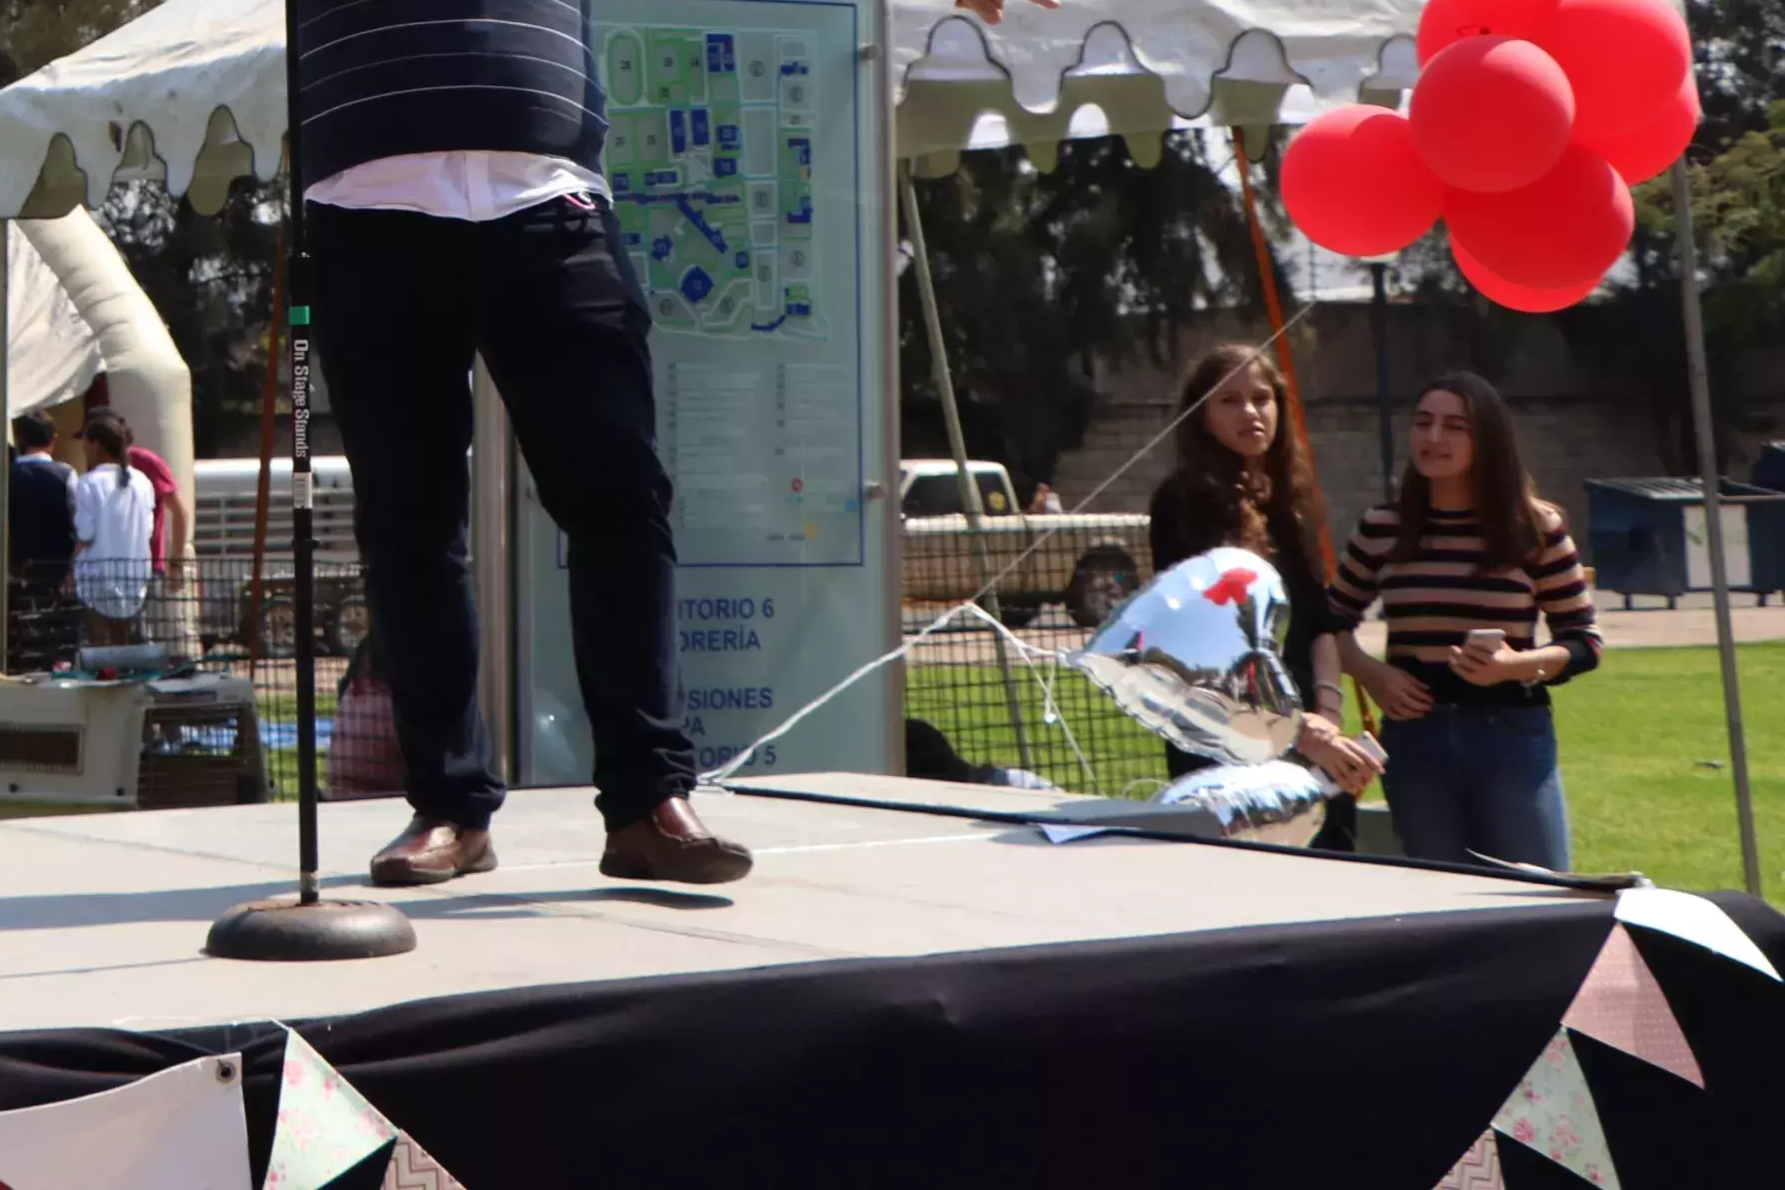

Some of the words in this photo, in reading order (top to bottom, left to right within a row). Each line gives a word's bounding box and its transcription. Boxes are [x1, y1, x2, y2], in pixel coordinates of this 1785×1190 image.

[293, 339, 310, 361] On
[292, 365, 311, 407] Stage
[294, 409, 311, 458] Stands
[762, 598, 775, 619] 6
[764, 743, 777, 766] 5
